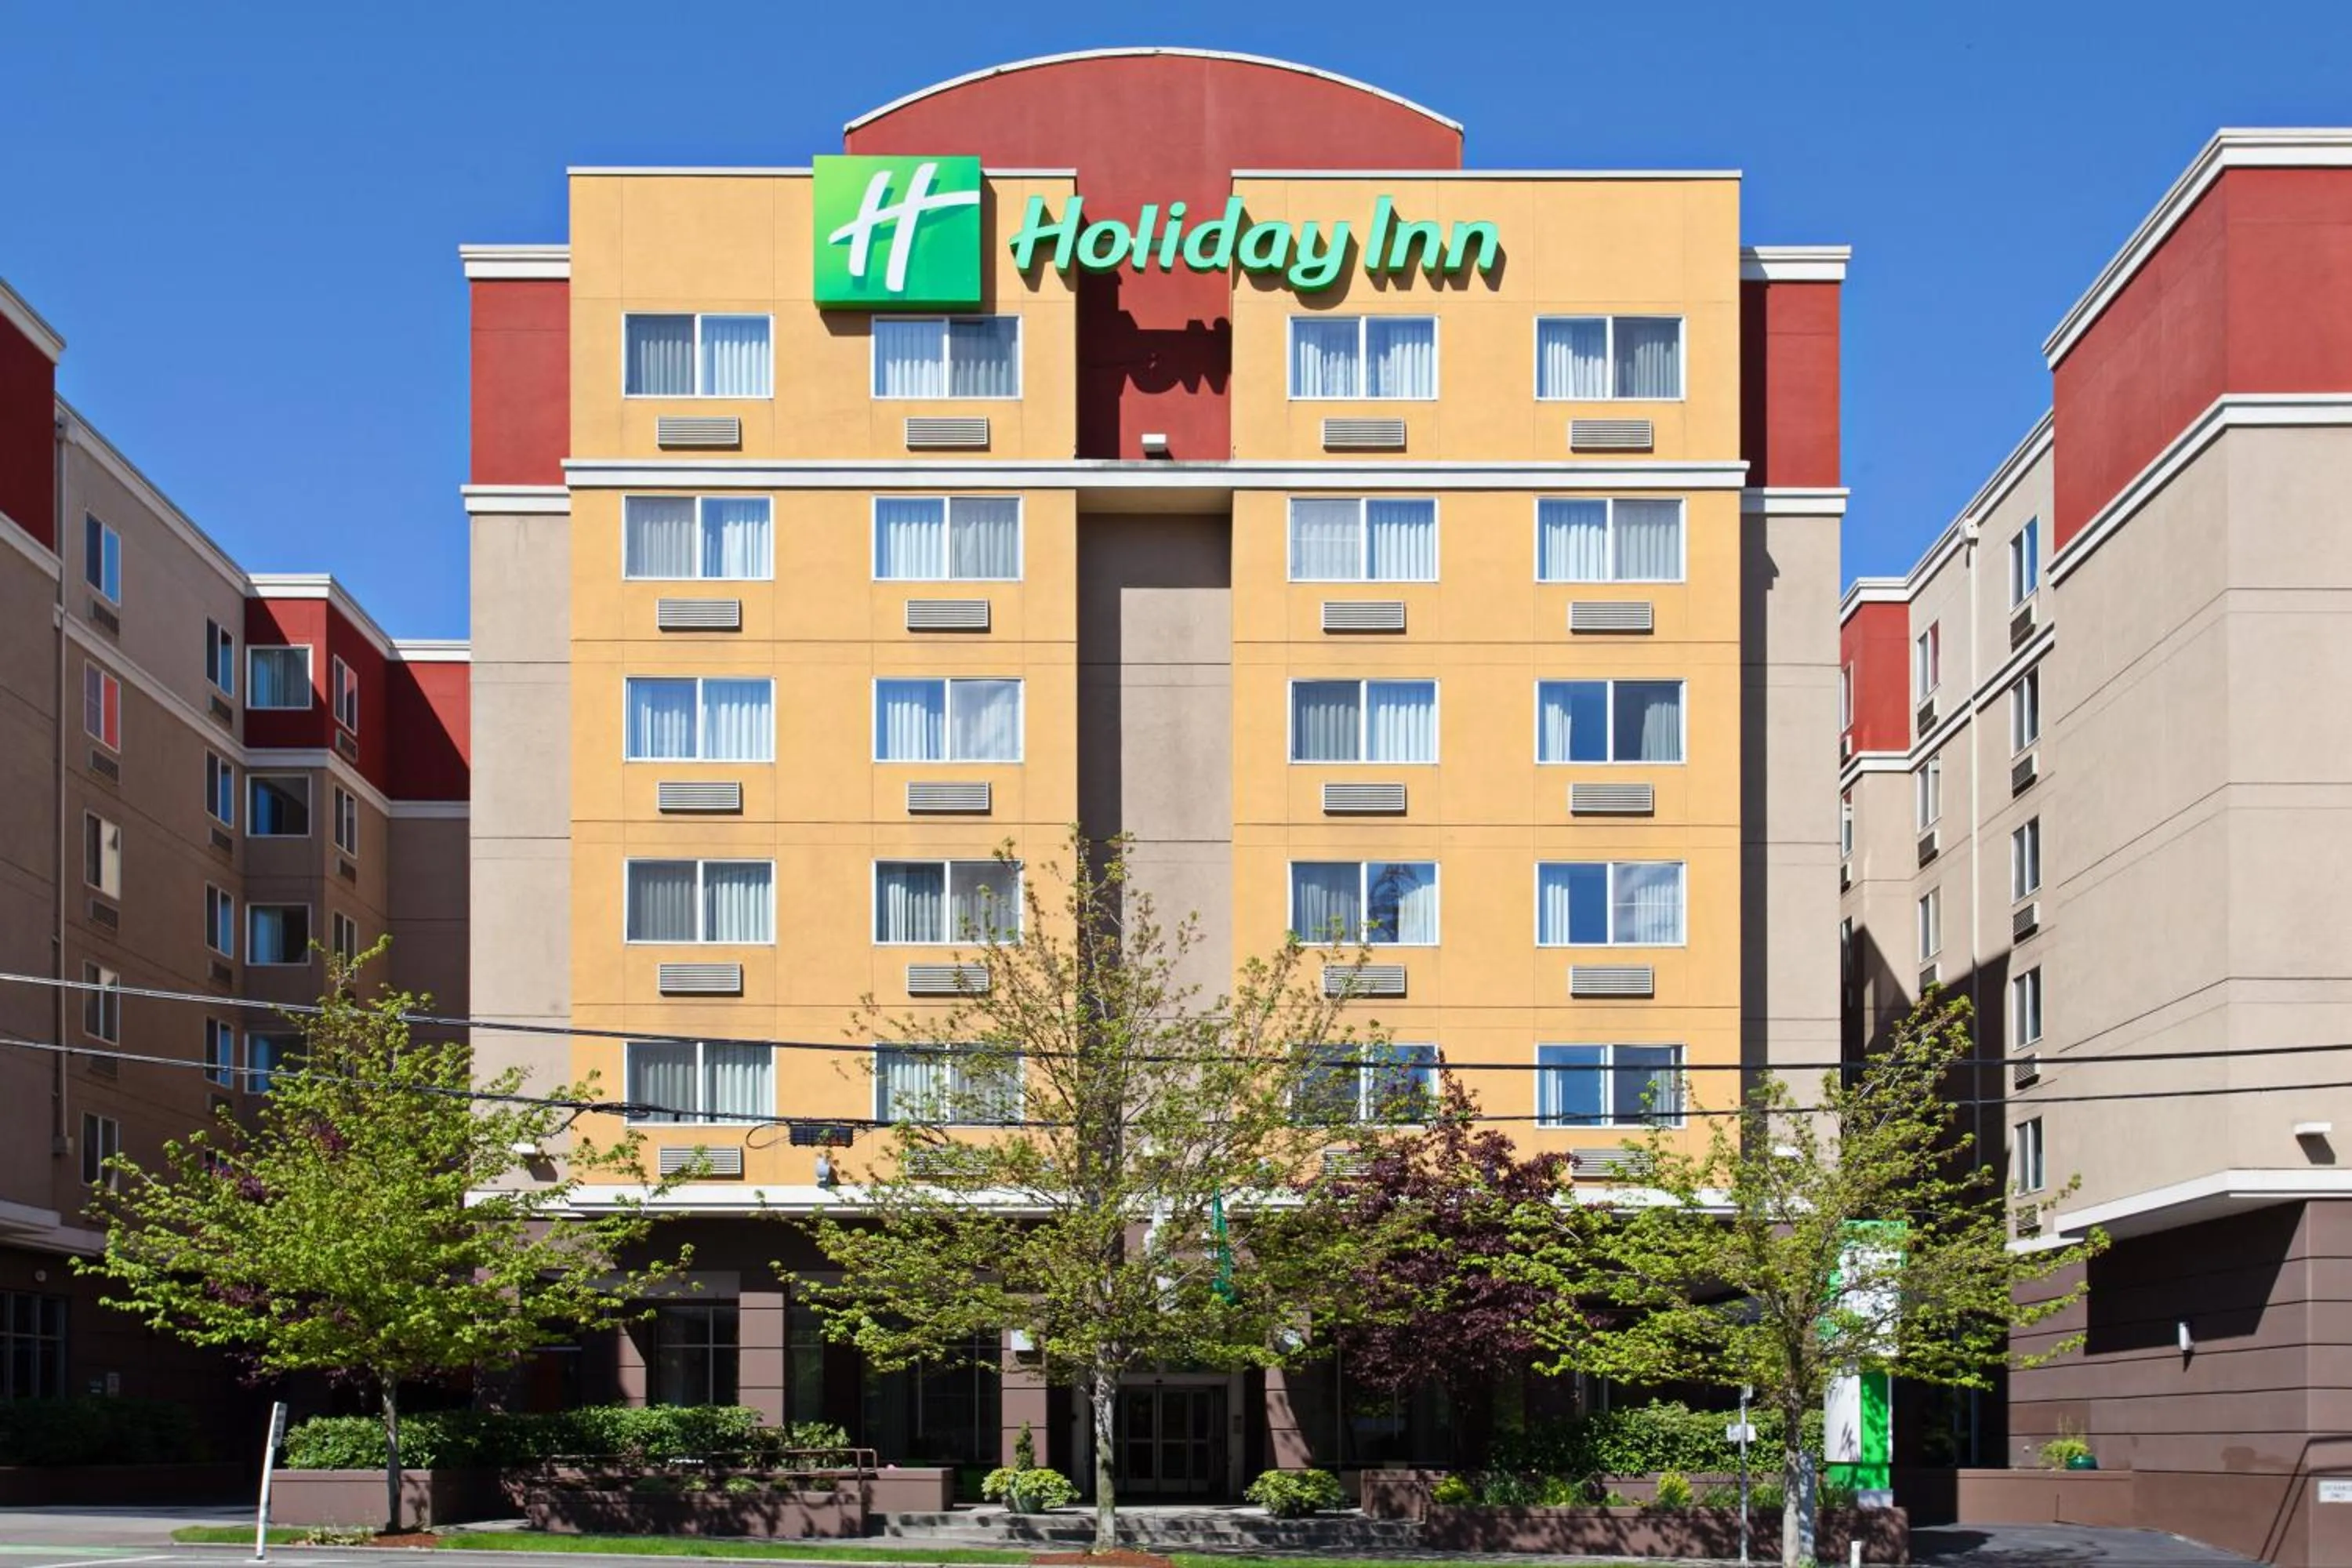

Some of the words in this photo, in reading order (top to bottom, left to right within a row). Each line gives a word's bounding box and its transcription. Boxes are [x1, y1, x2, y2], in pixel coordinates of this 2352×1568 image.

[829, 162, 980, 292] H
[1010, 195, 1351, 291] Holiday
[1364, 194, 1500, 274] Inn
